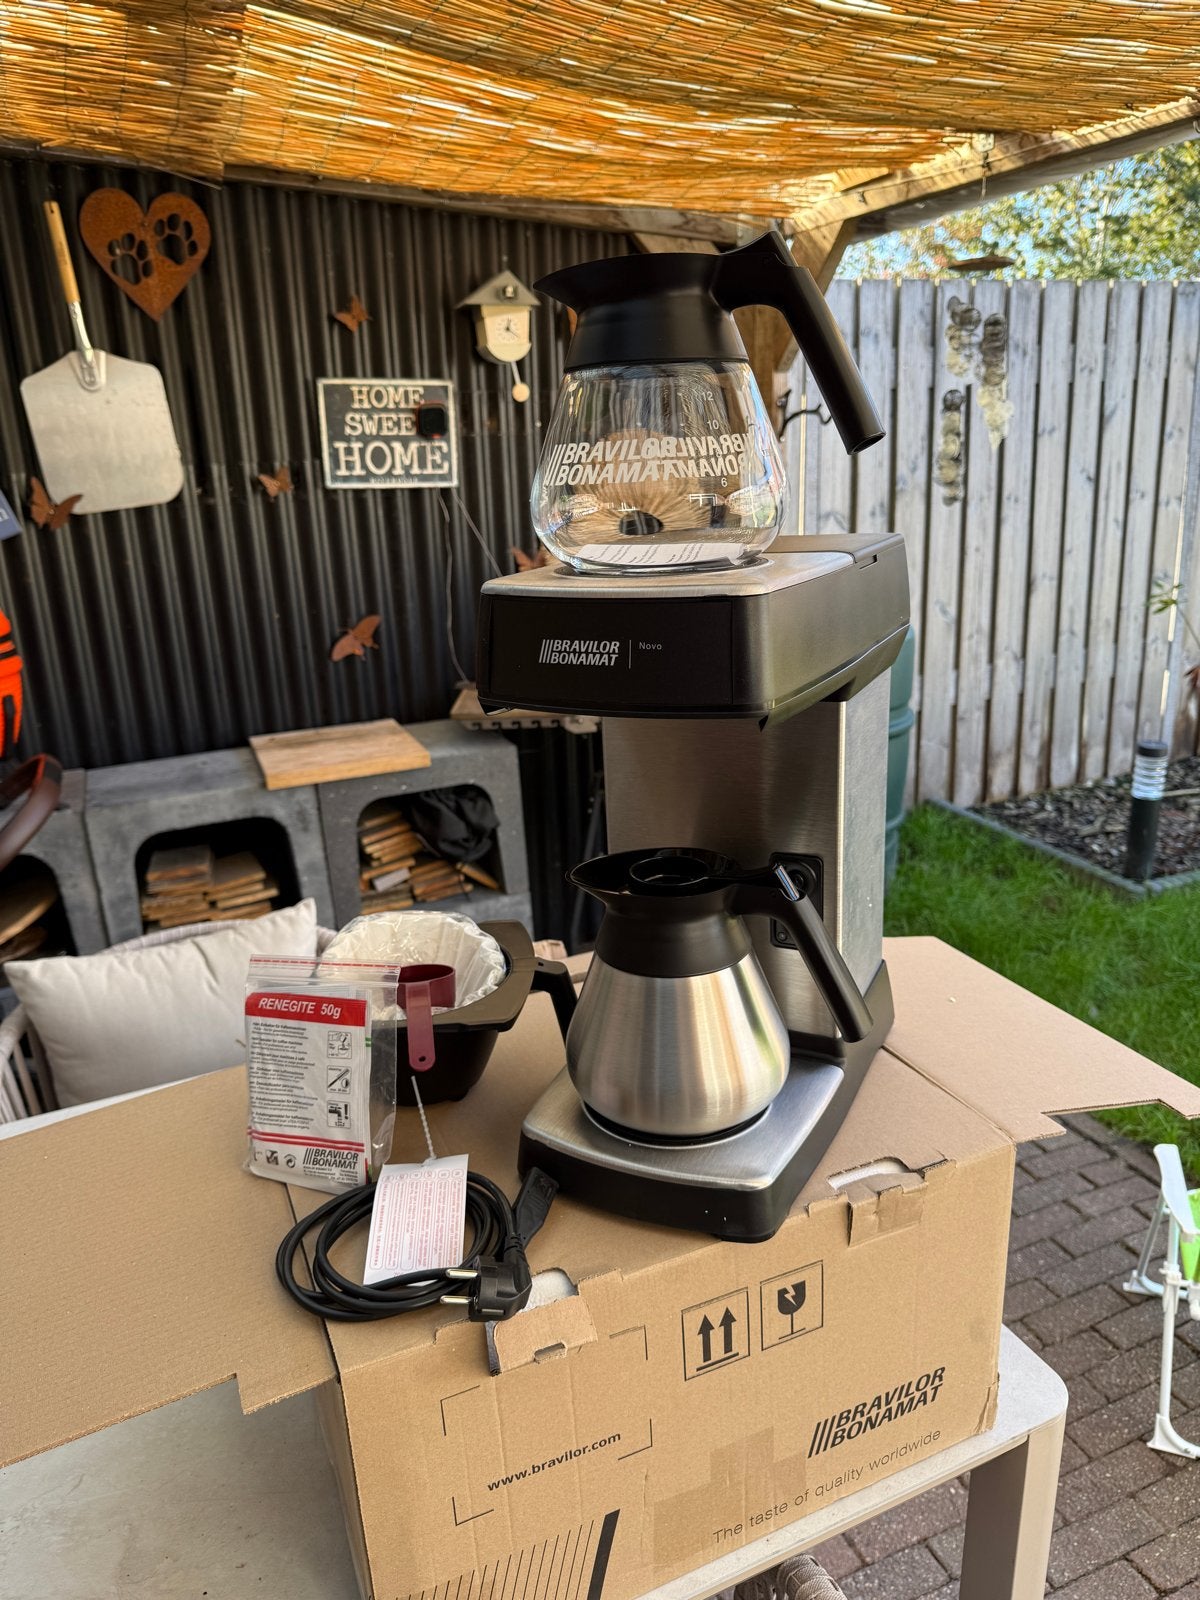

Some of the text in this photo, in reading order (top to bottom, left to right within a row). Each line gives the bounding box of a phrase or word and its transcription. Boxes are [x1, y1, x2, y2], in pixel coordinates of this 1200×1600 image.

[350, 386, 425, 409] HOME
[702, 391, 713, 401] 12
[344, 412, 417, 436] SWEE
[707, 420, 719, 430] 10
[333, 440, 449, 476] HOME
[721, 478, 728, 488] 6
[552, 639, 663, 654] BRAVILOR Novo
[550, 652, 619, 666] BONAMAT
[258, 997, 342, 1019] RENEGITE 50g
[311, 1157, 358, 1170] BONAMAT
[313, 1148, 359, 1161] BRAVILOR
[835, 1366, 946, 1429] BRAVILOR
[830, 1383, 943, 1449] BONAMAT
[487, 1433, 621, 1491] www.bravilor.com
[712, 1428, 941, 1544] The taste of quality worldwide
